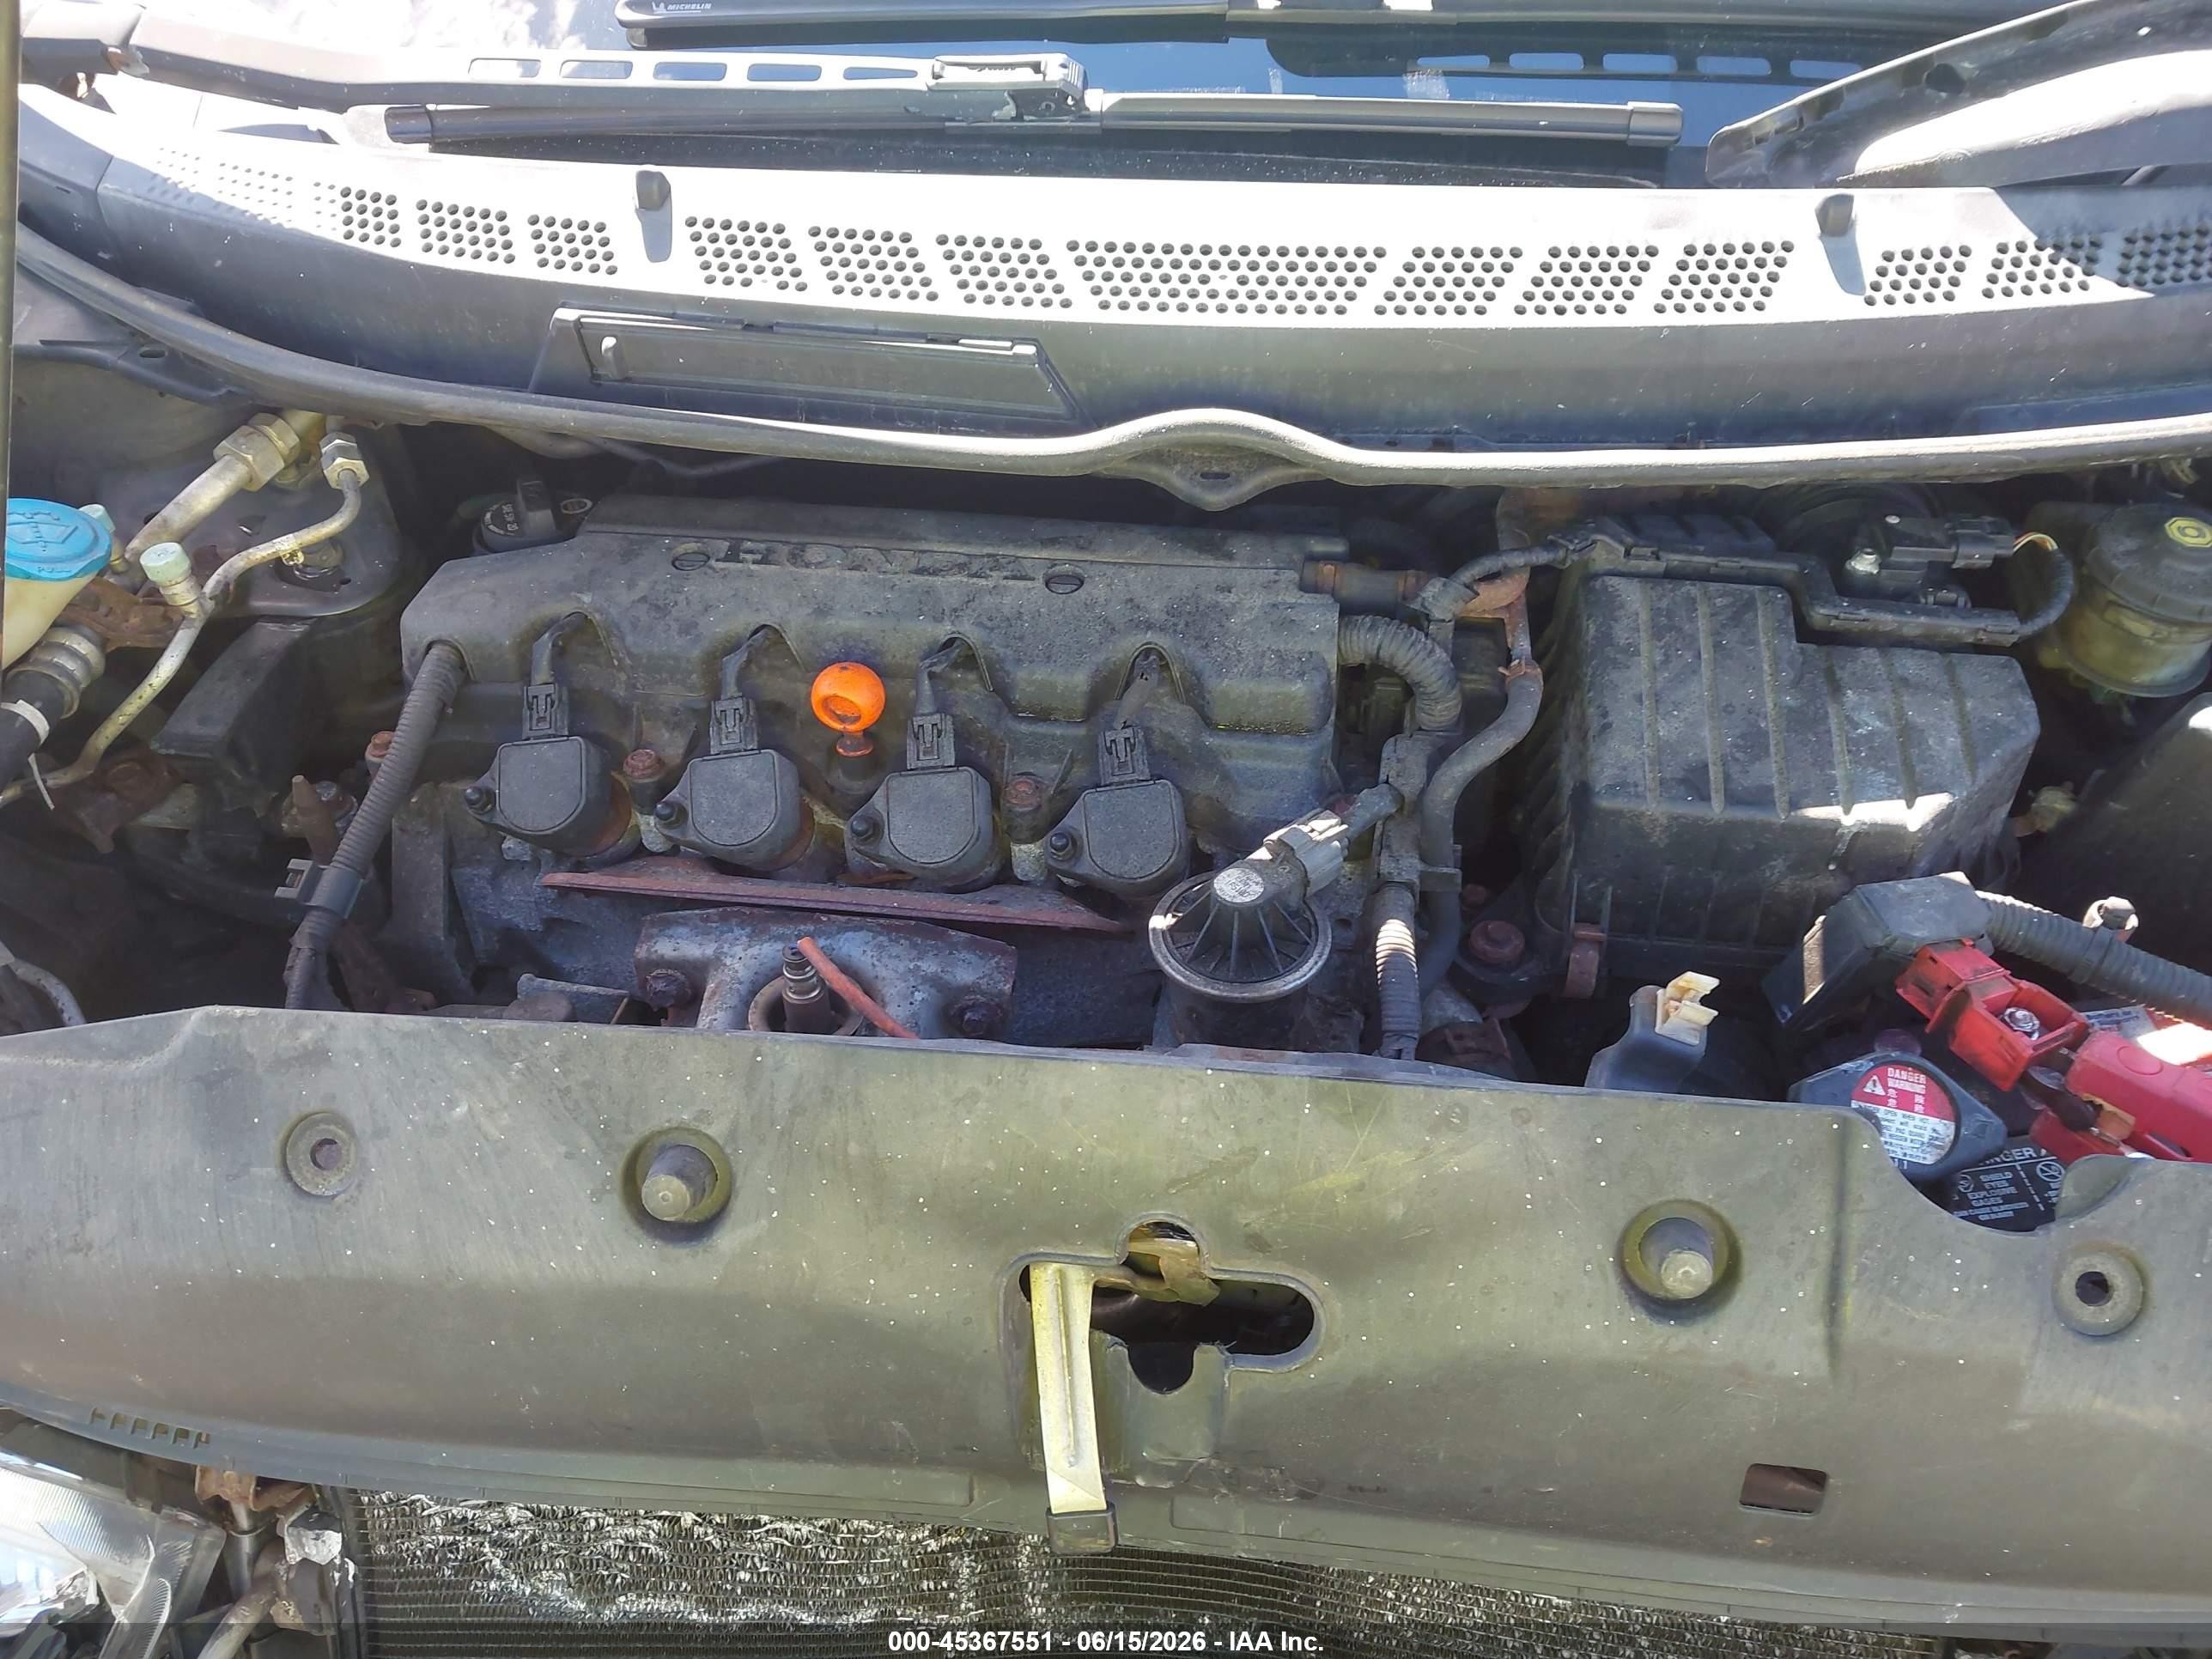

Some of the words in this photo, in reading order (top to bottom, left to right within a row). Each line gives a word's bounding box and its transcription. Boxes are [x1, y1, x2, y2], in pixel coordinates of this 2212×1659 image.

[715, 538, 1036, 581] HONDA
[1887, 1067, 1926, 1084] DANGER
[1979, 1172, 2014, 1182] SHIELD
[1984, 1180, 2010, 1189] EYES
[1966, 1187, 2019, 1200] EXPLOSIVE
